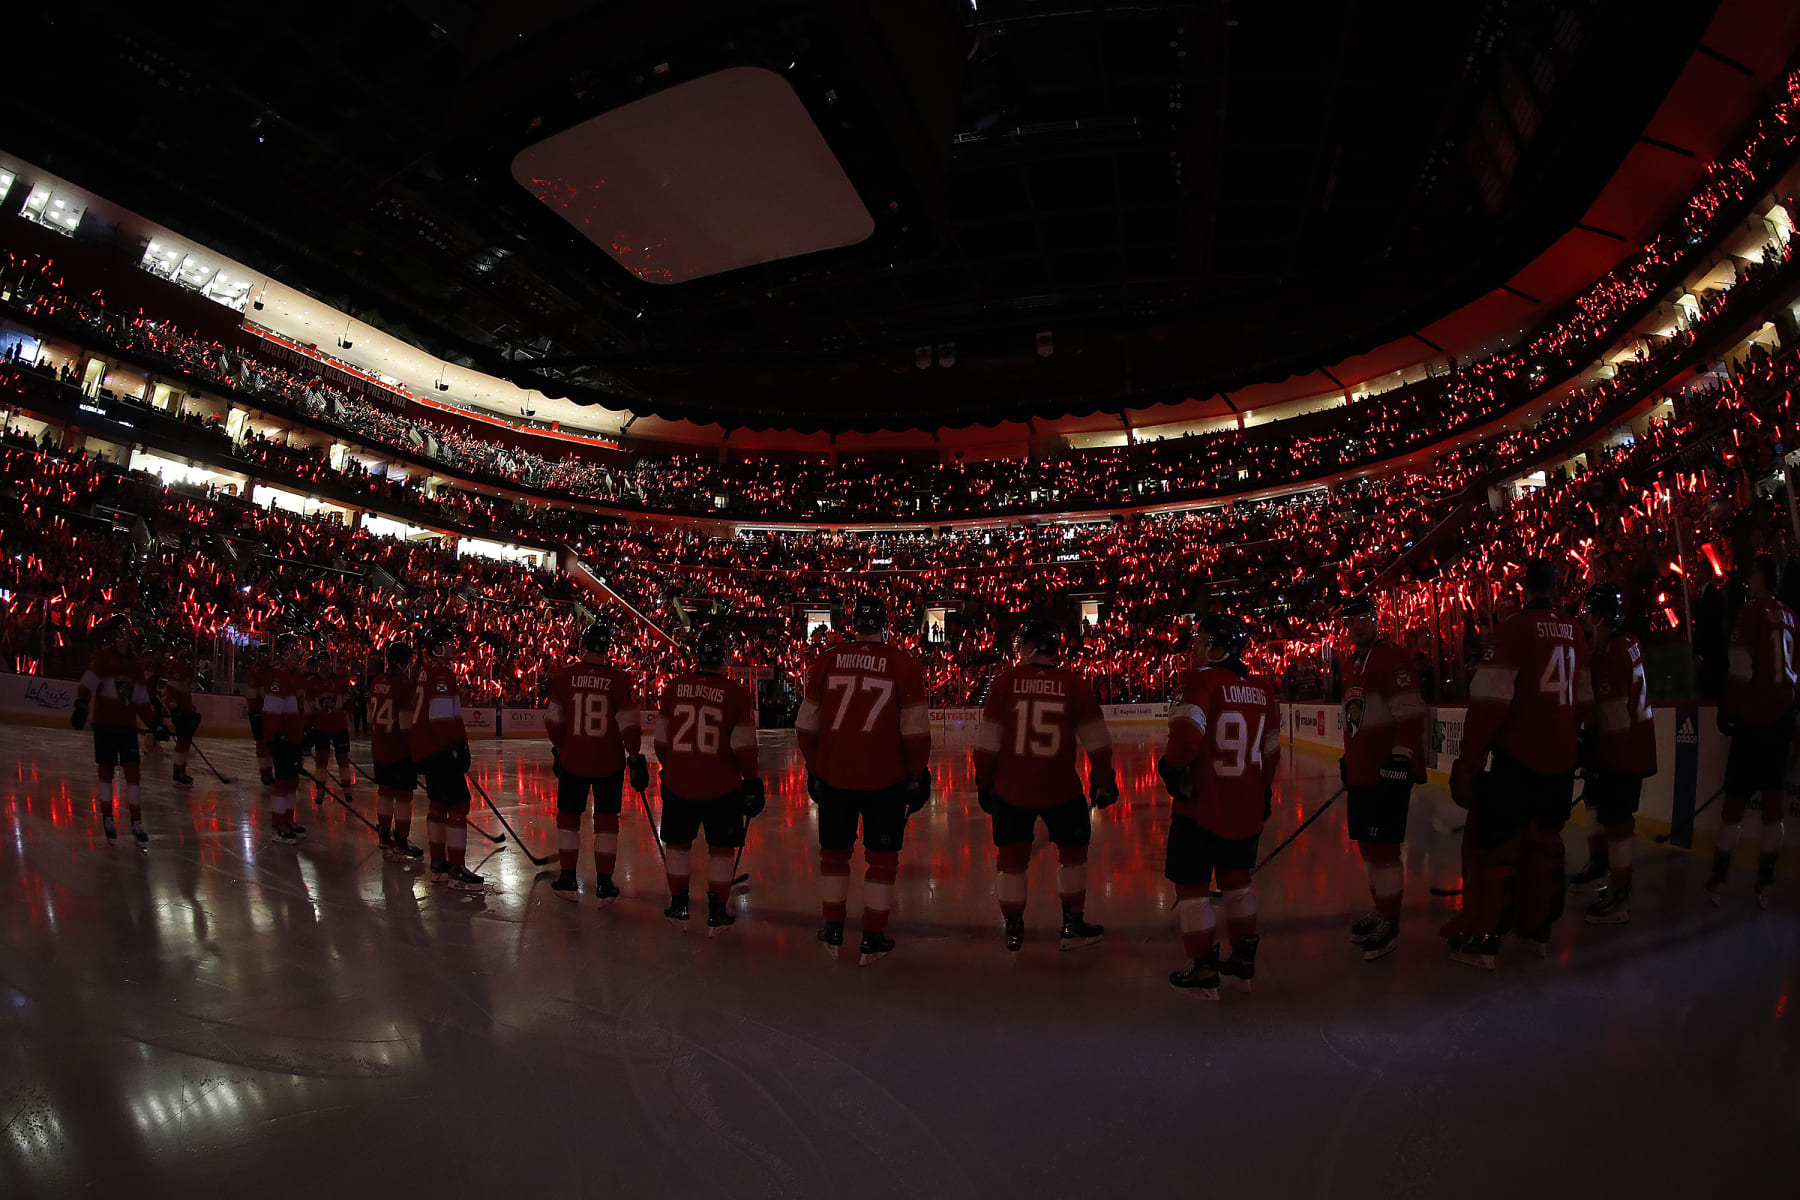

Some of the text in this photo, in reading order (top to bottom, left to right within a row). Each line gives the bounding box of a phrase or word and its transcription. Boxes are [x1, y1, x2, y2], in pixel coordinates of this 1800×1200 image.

[259, 340, 408, 409] ROGER NEILSON MEMORIAL PRESS BOX
[1537, 621, 1574, 640] STOLARZ
[571, 675, 612, 691] LORENTZ
[836, 653, 888, 673] MIKKOLA
[1539, 644, 1576, 707] 41
[827, 675, 894, 733] 77
[1012, 677, 1066, 696] LUNDELL
[1222, 685, 1267, 706] LOMBERG
[571, 692, 609, 736] 18
[672, 703, 724, 755] 26
[929, 711, 976, 721] SEATGEEK
[1012, 699, 1065, 757] 15
[1213, 711, 1266, 777] 94
